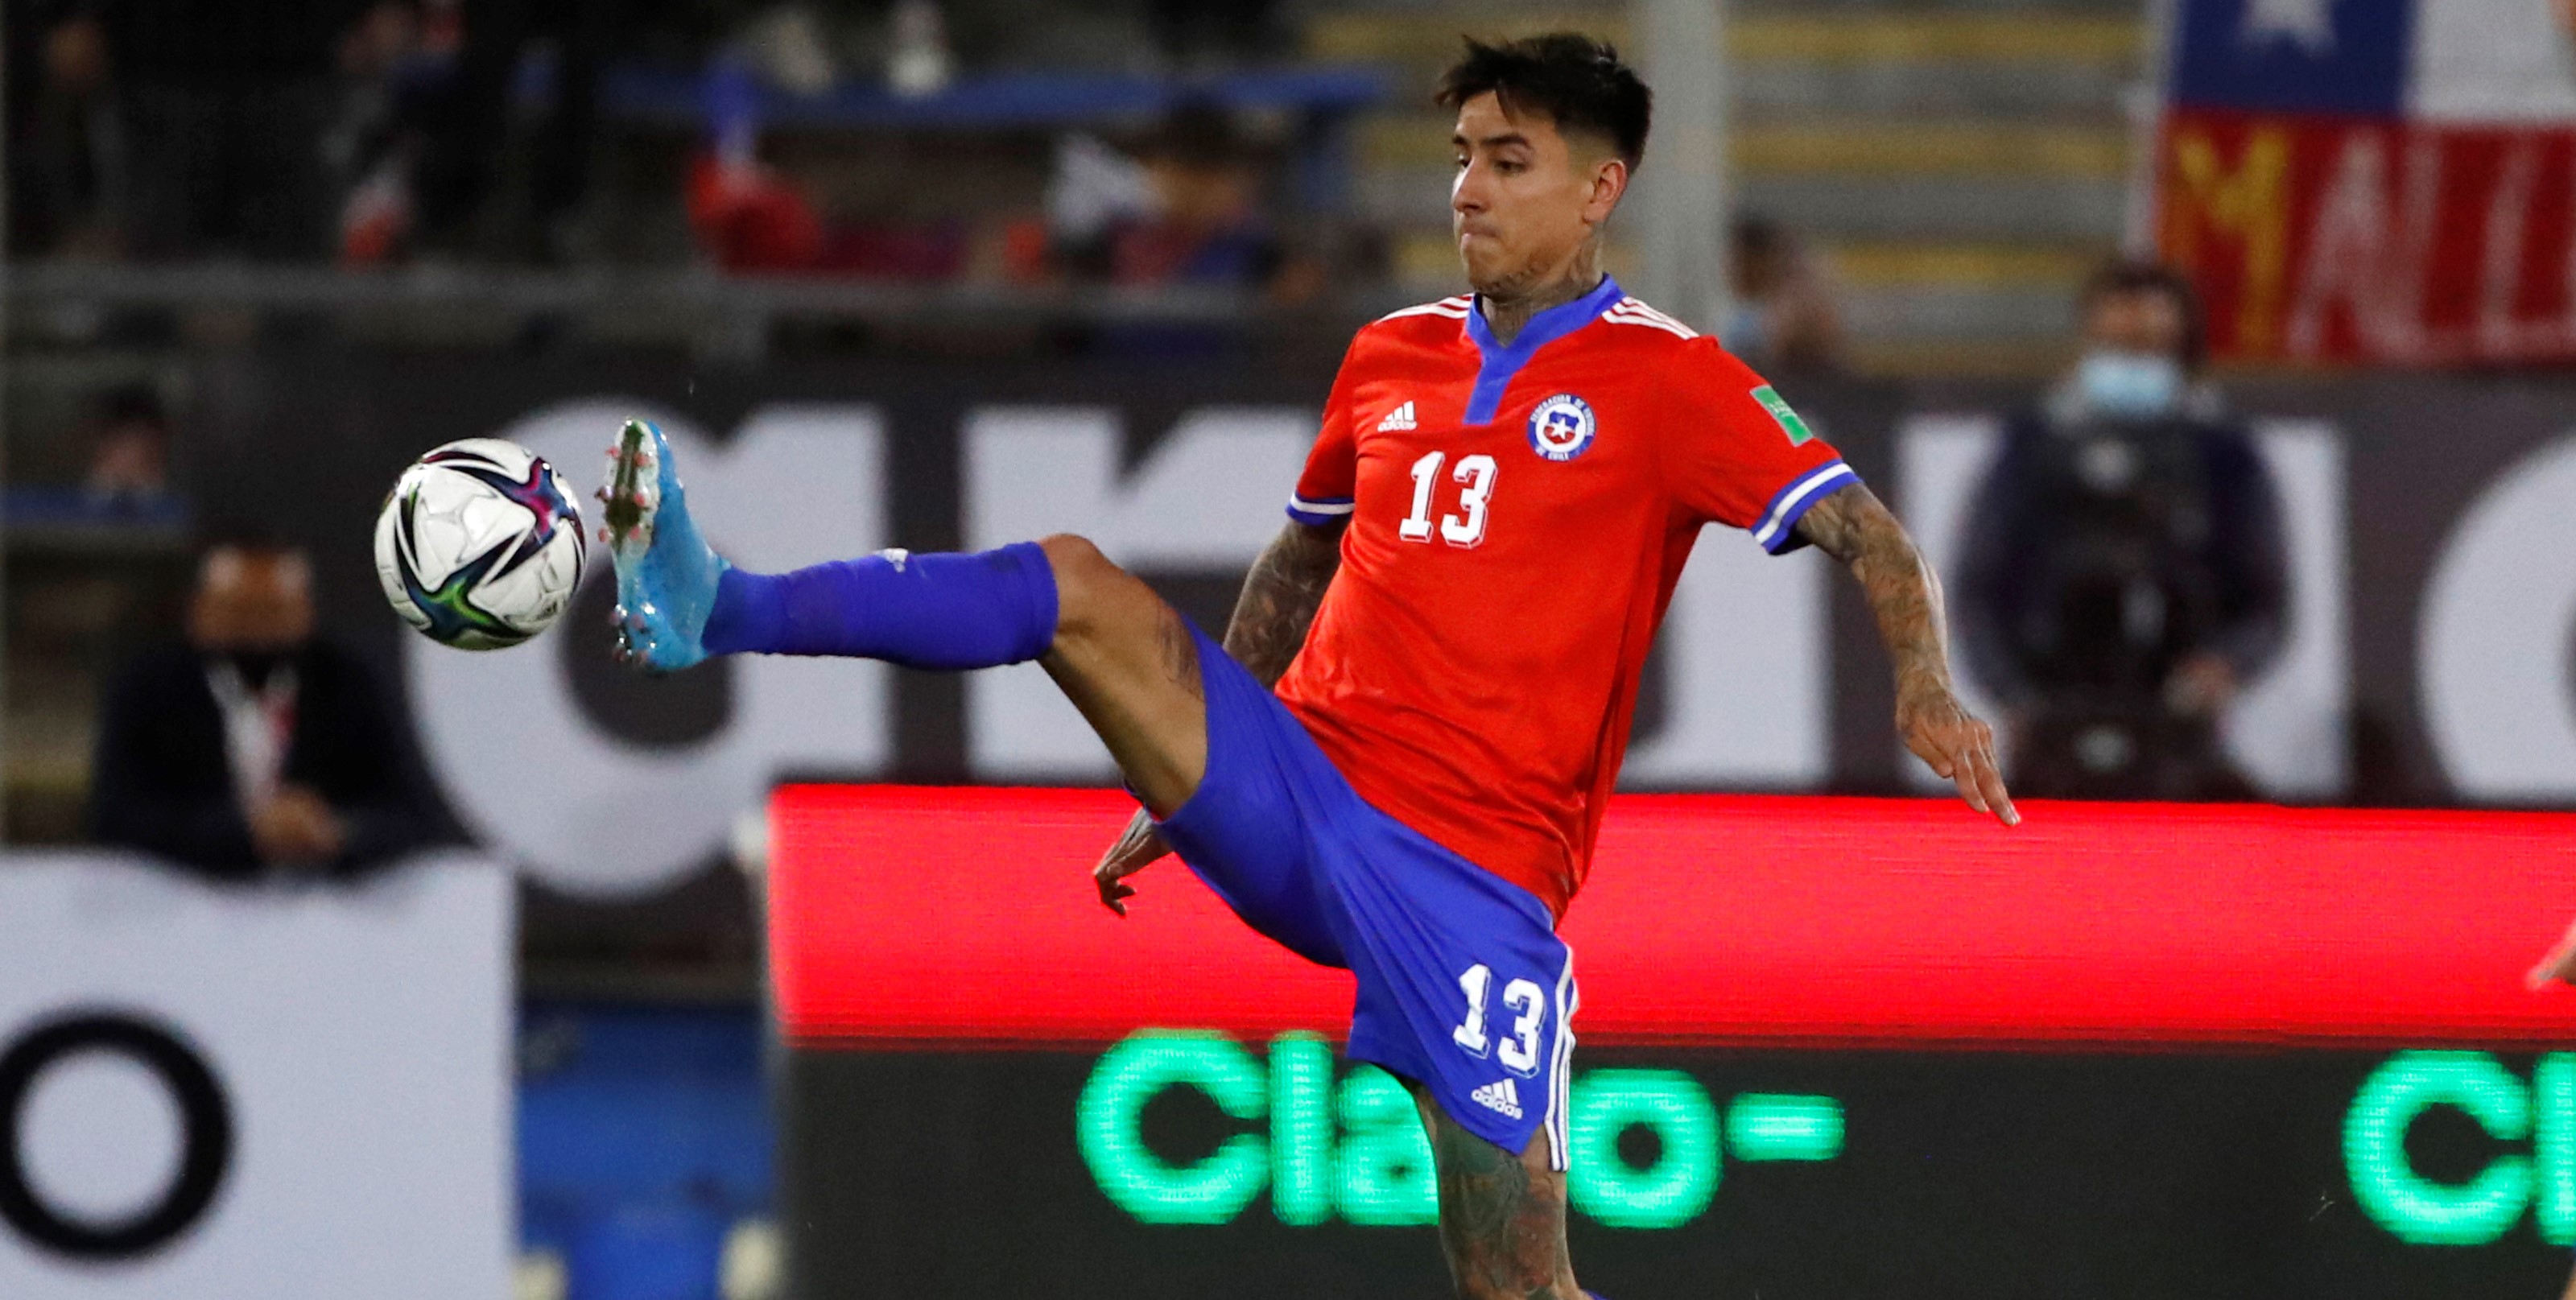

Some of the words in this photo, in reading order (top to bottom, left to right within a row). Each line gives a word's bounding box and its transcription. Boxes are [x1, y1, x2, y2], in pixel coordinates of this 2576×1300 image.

[2159, 129, 2576, 354] MALL
[1399, 450, 1498, 550] 13
[1452, 963, 1547, 1079] 13
[1471, 1088, 1524, 1121] adidas
